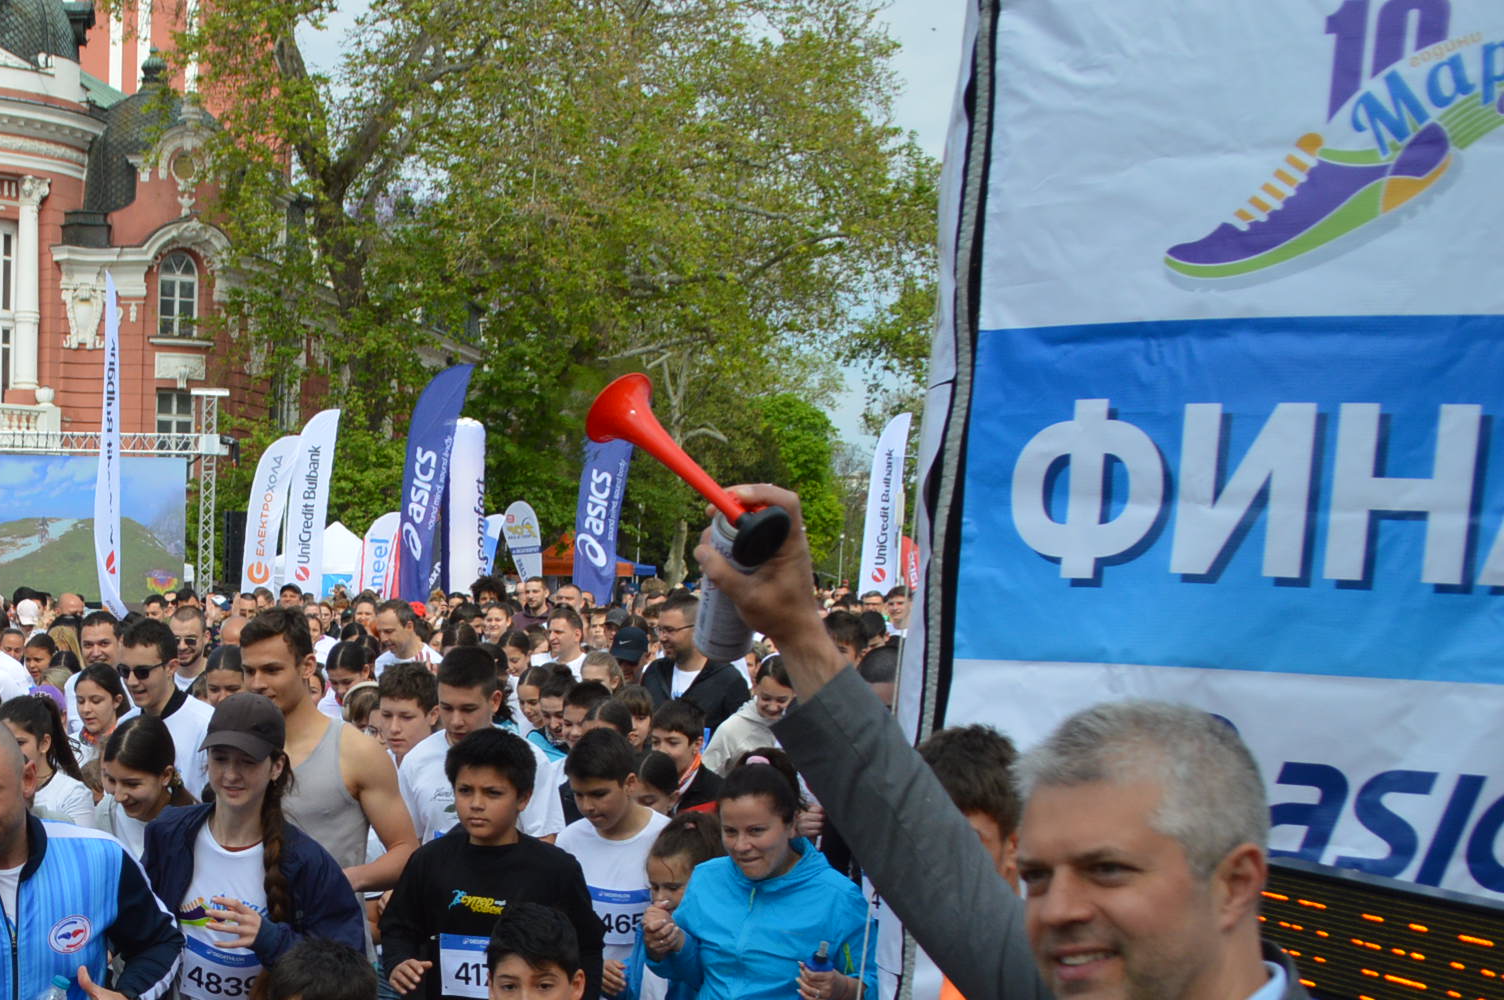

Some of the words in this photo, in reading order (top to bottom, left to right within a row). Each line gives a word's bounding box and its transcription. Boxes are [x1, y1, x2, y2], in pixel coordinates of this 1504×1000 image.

[1325, 0, 1452, 125] 10
[1351, 40, 1504, 157] Мар
[302, 443, 322, 500] Bulbank
[407, 446, 437, 524] asics
[584, 468, 613, 536] asics
[880, 448, 896, 502] Bulbank
[1011, 399, 1504, 587] ФИН
[255, 455, 284, 557] ЕЛЕКТРОХОЛД
[297, 503, 315, 564] UniCredit
[874, 504, 891, 566] UniCredit
[1268, 761, 1504, 894] asic
[603, 912, 643, 934] 465
[454, 962, 490, 986] 417
